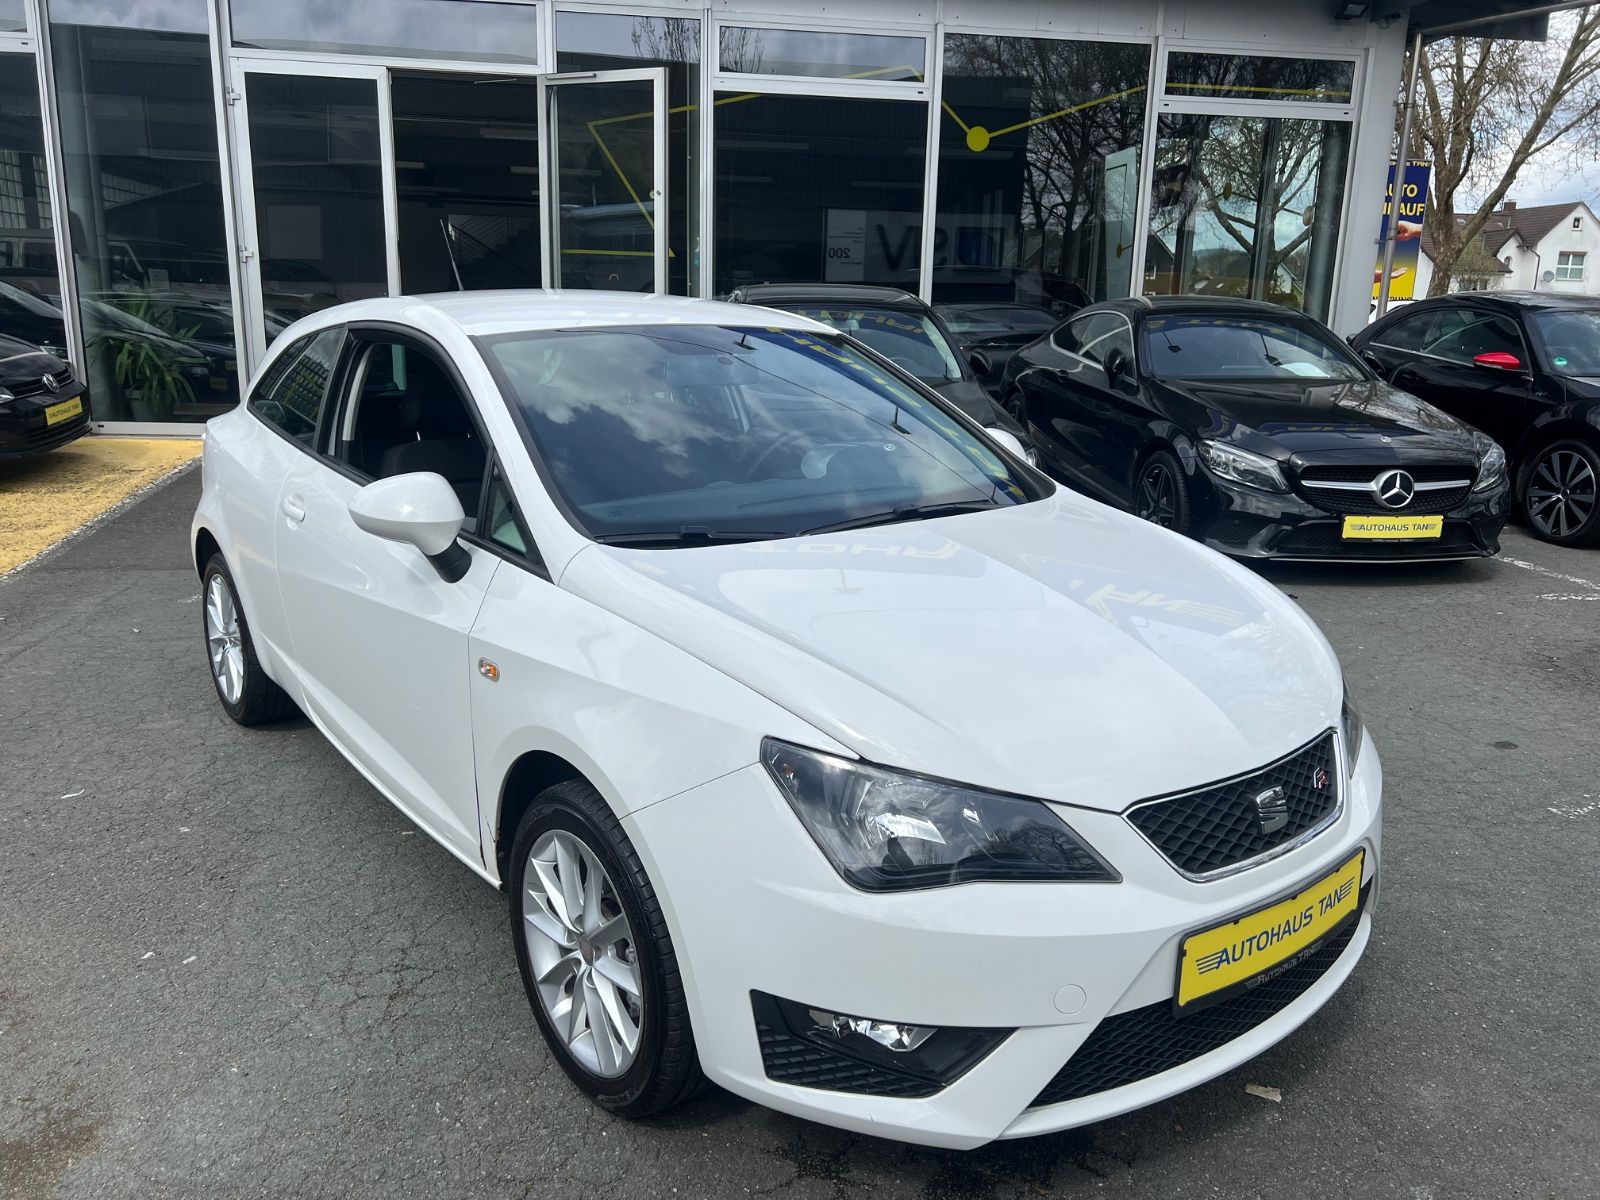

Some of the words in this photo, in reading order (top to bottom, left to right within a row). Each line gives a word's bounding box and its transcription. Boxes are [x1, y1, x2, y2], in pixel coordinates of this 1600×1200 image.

[1359, 523, 1409, 532] AUTOHAUS
[1412, 523, 1429, 531] TAN
[1216, 905, 1314, 970] AUTOHAUS
[1318, 885, 1345, 917] TAN
